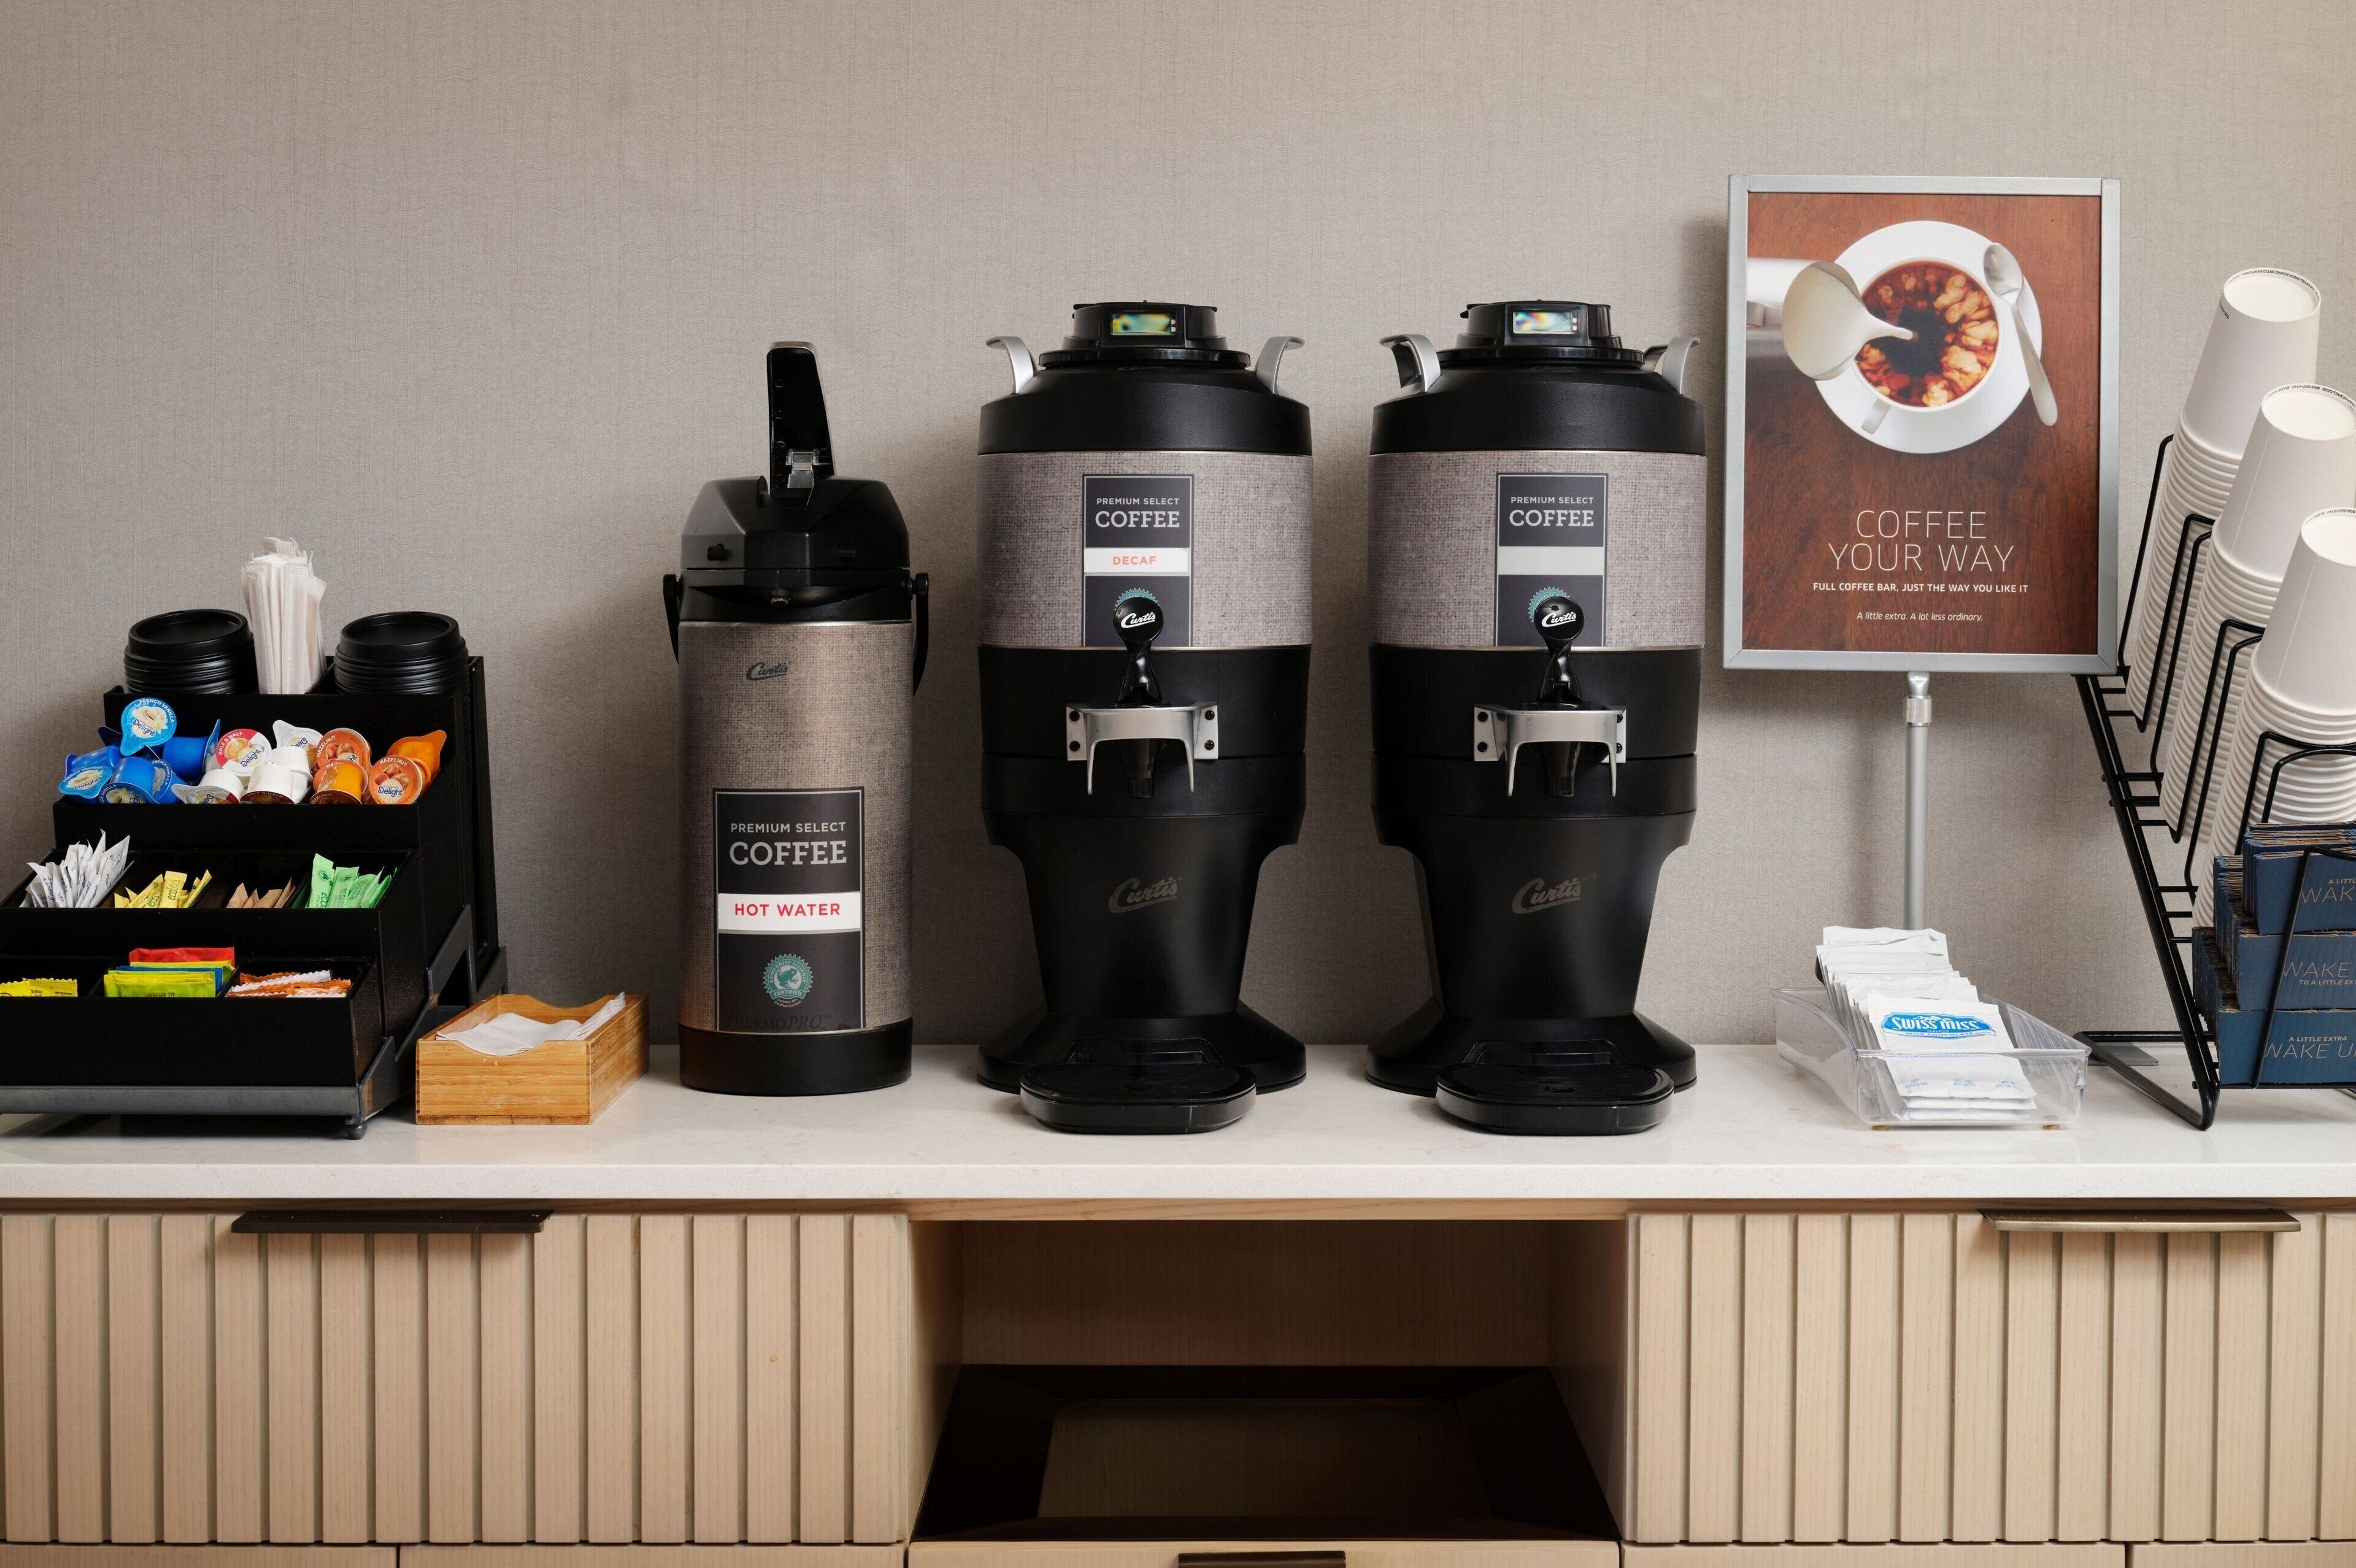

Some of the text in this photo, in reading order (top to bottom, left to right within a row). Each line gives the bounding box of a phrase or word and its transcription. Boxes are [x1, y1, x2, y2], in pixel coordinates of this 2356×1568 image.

[2275, 271, 2300, 281] PACKAGING
[1095, 510, 1180, 528] COFFEE
[1509, 509, 1594, 527] COFFEE
[1857, 510, 1987, 539] COFFEE
[1112, 556, 1157, 565] DECAF
[1828, 543, 2014, 572] YOUR WAY
[1813, 582, 2028, 594] FULL COFFEE BAR, JUST THE WAY YOU LIKE IT
[1120, 612, 1156, 629] Curtis
[1541, 611, 1577, 628] Curtis
[1857, 612, 1863, 620] A
[1865, 612, 1883, 620] little
[1910, 612, 1916, 621] A
[1919, 612, 1929, 621] lot
[1931, 612, 1946, 621] less
[1947, 613, 1984, 622] ordinary.
[746, 661, 788, 681] Curtis
[162, 703, 175, 723] VANILLA
[132, 718, 156, 736] Delight
[228, 731, 244, 740] HALF
[316, 734, 336, 757] HAZELNUT
[240, 748, 261, 767] Delight
[379, 756, 408, 766] HAZELNUT
[377, 786, 403, 797] Delight
[731, 821, 846, 833] PREMIUM SELECT
[730, 840, 847, 866] COFFEE
[1108, 877, 1178, 913] Curtis
[1511, 877, 1582, 914] Curtis
[2301, 885, 2354, 904] WAK
[735, 902, 841, 917] HOT WATER
[769, 961, 806, 983] RAINFOREST ALLIANCE
[2338, 1042, 2356, 1058] U
